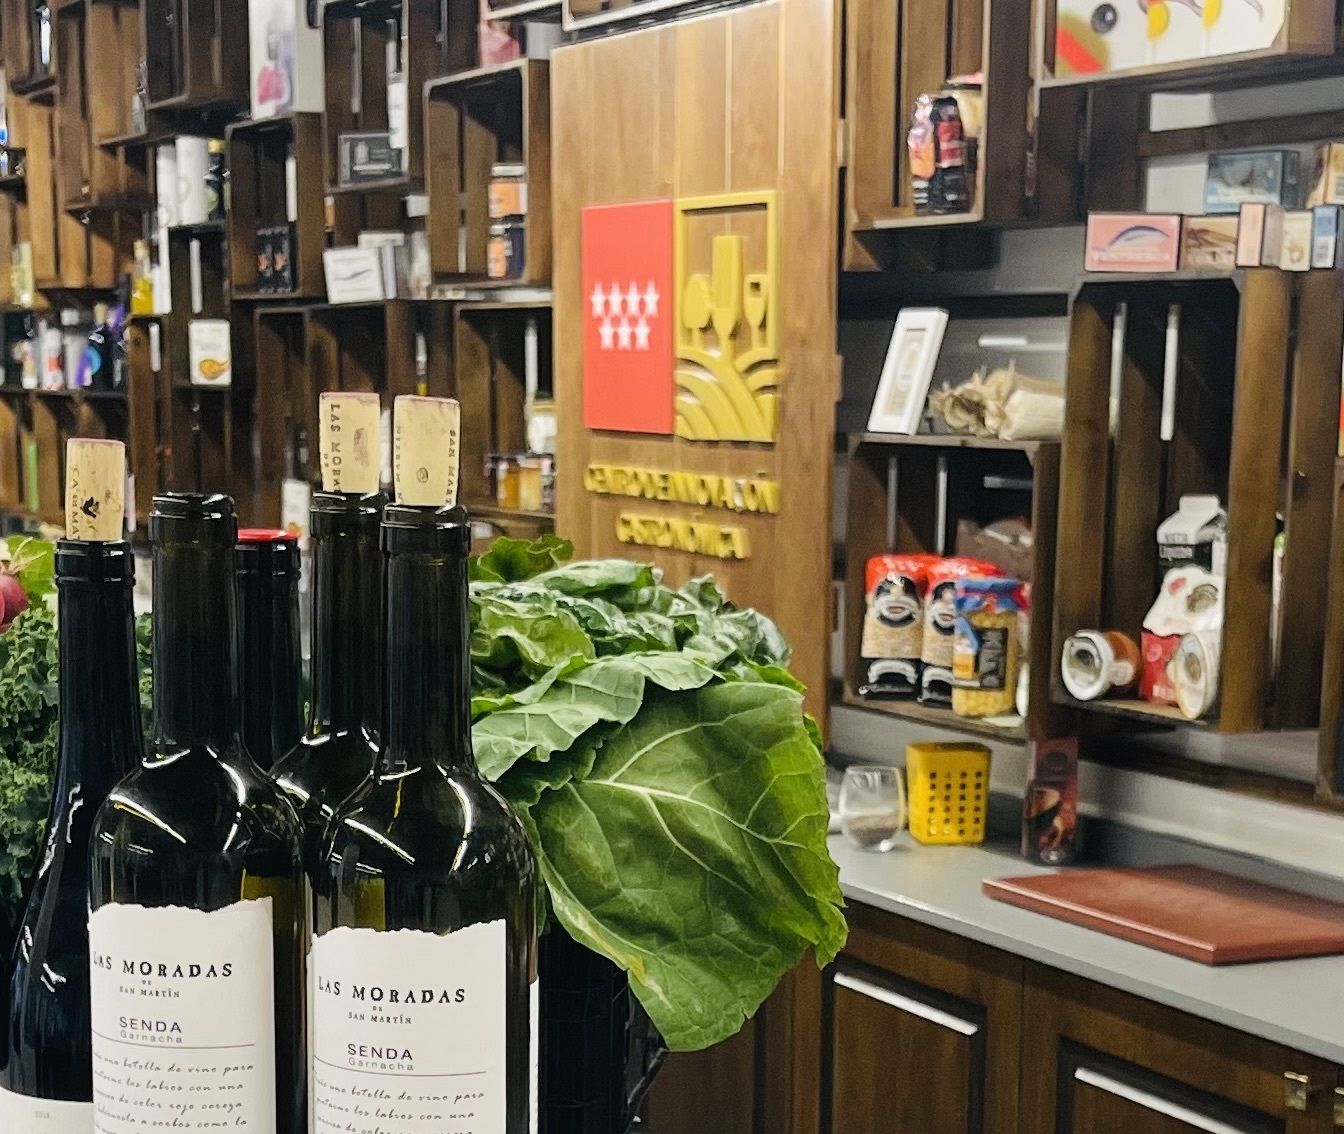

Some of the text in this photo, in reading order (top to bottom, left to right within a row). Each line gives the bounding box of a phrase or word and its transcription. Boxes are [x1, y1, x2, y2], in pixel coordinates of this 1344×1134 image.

[330, 403, 341, 432] LAS
[93, 951, 233, 978] LAS MORADAS
[318, 976, 466, 1004] LAS MORADAS
[119, 1016, 182, 1034] SENDA
[348, 1011, 365, 1021] SAN
[120, 1030, 183, 1044] Garnacha
[347, 1043, 413, 1061] SENDA
[348, 1058, 414, 1071] Garnacha
